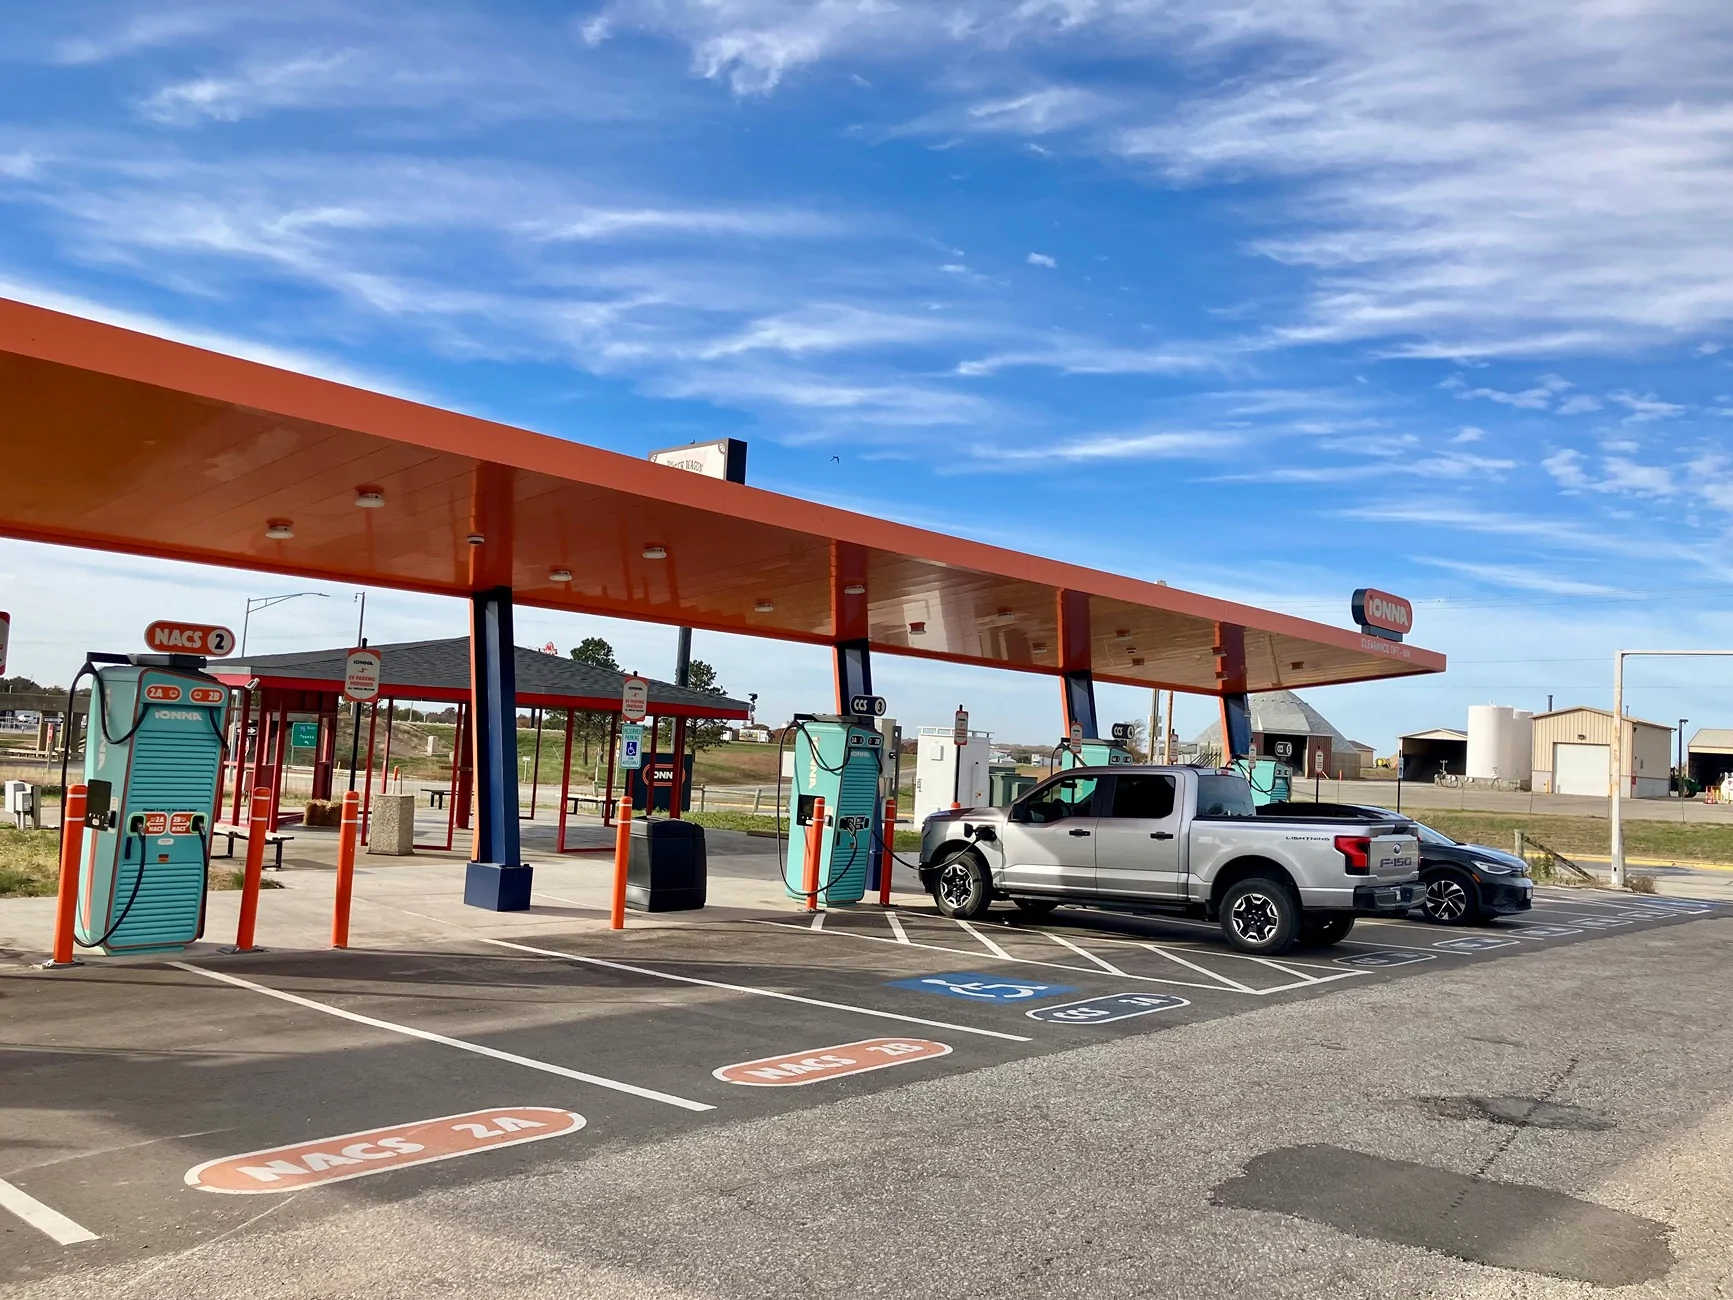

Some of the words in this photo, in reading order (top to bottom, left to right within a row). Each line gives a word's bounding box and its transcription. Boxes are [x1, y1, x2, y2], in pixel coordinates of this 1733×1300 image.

[154, 627, 203, 649] NACS
[214, 633, 225, 650] 2
[149, 688, 163, 698] 2A
[208, 691, 220, 701] 2B
[853, 698, 868, 711] CCS
[877, 701, 883, 712] 3
[1113, 726, 1123, 736] CCS
[1379, 856, 1412, 868] F-150
[742, 1054, 858, 1080] NACS
[865, 1043, 925, 1056] 2B
[235, 1137, 425, 1183] NACS
[450, 1116, 548, 1139] 2A
